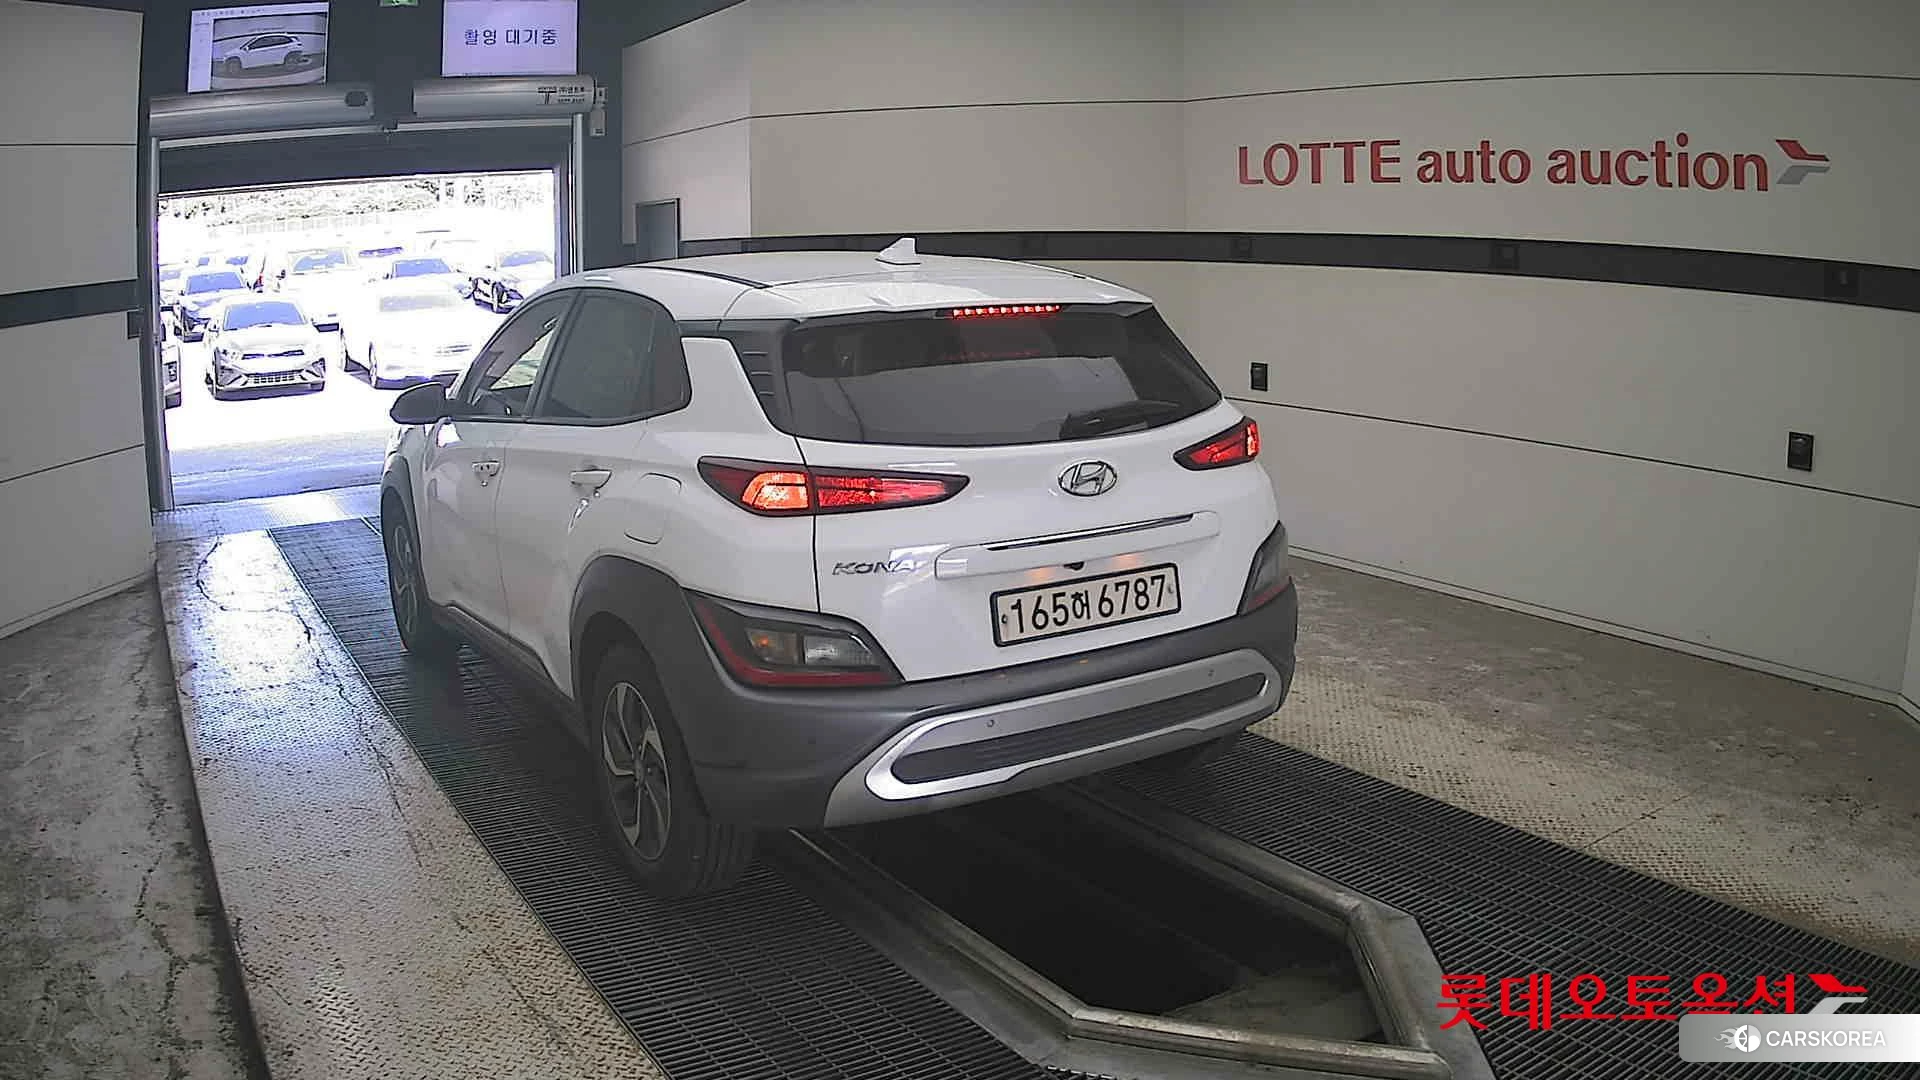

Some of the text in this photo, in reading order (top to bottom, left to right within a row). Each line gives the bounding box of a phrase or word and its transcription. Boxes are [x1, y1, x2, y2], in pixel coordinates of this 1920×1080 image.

[464, 28, 557, 46] 촬영 대기중
[1238, 132, 1769, 192] LOTTE auto auction
